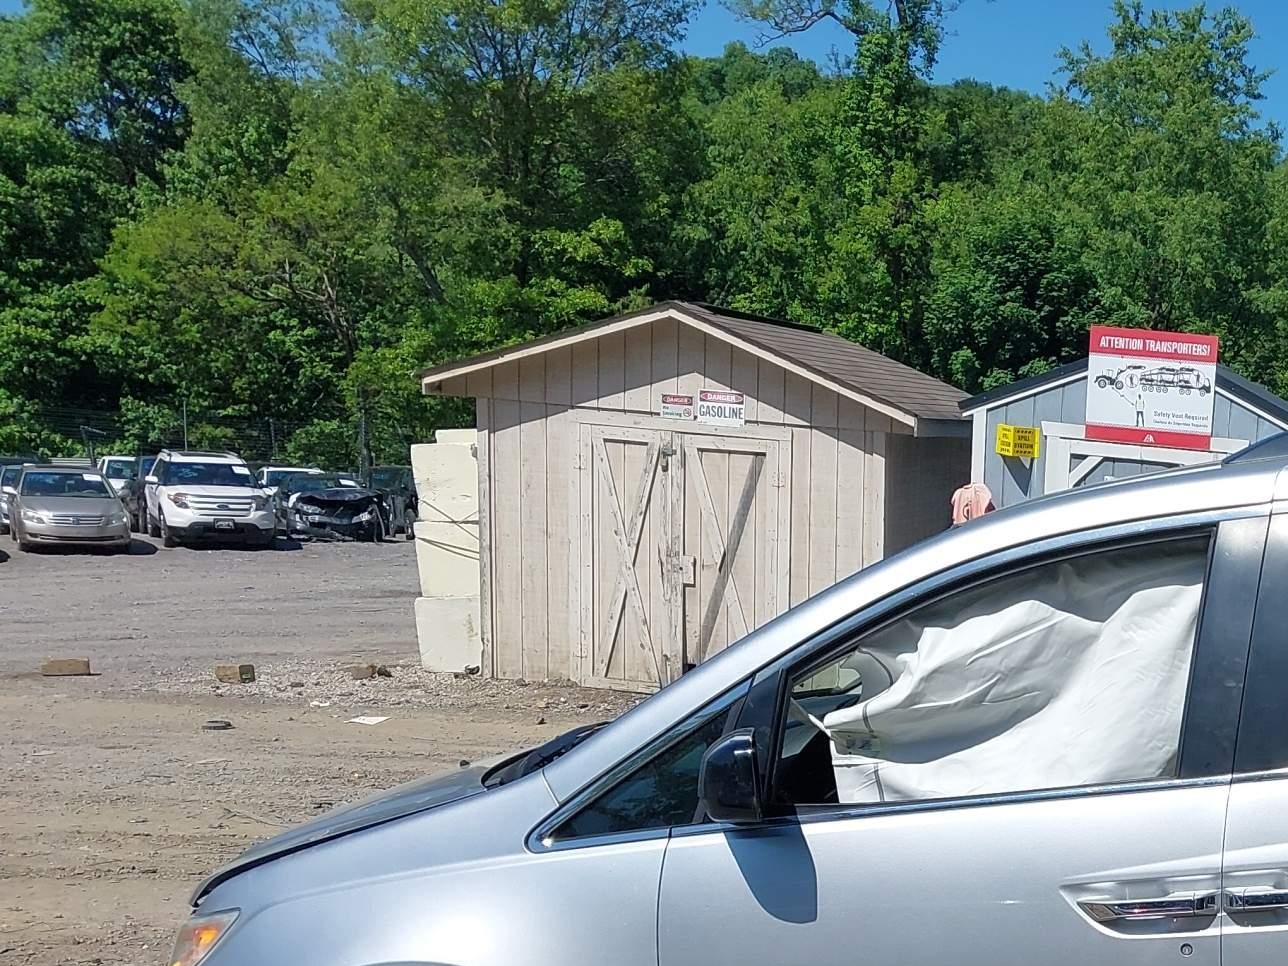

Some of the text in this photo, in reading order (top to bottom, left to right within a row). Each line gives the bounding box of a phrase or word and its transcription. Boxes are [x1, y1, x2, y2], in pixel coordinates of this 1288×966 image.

[1099, 335, 1211, 356] ATTENTION TRANSPORTERS!
[707, 392, 736, 402] DANGER
[699, 404, 744, 420] GASOLINE
[1153, 411, 1171, 419] Safety
[1184, 412, 1209, 421] Required
